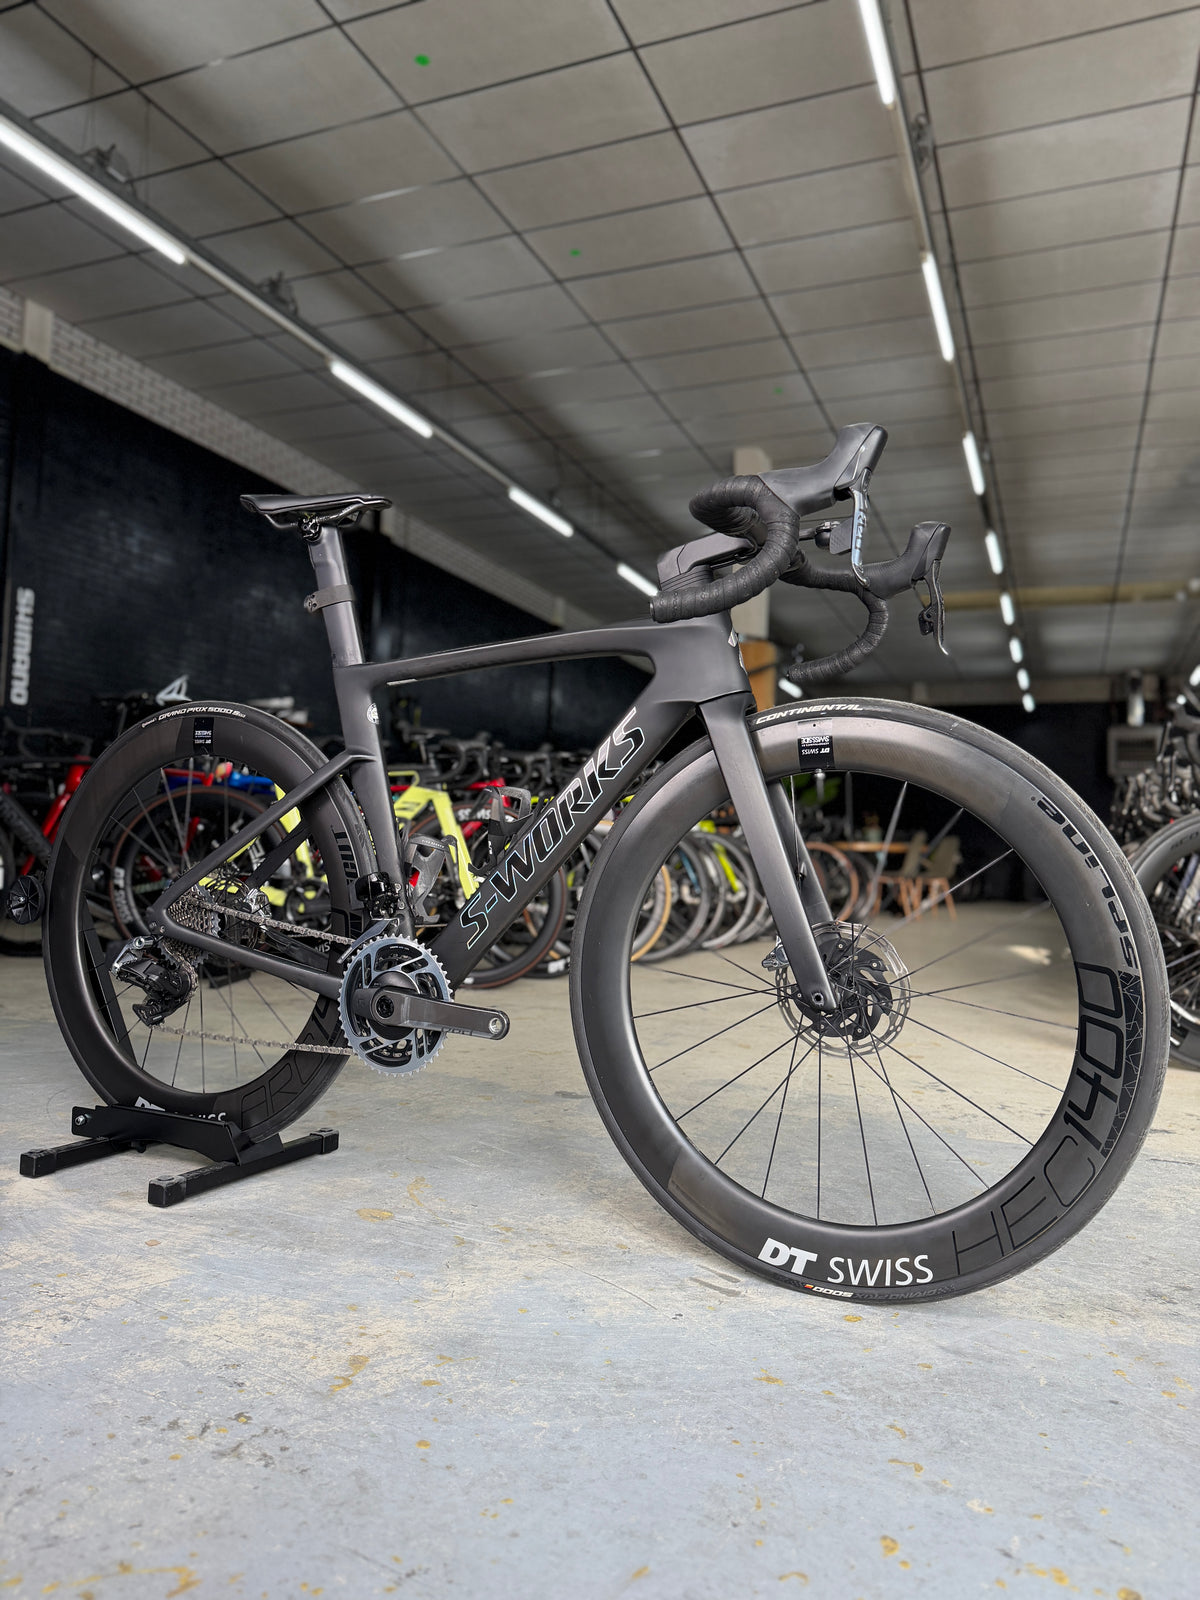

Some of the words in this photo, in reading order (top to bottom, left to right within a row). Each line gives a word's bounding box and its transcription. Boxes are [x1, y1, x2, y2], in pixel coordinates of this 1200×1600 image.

[10, 586, 35, 706] SHIMANO
[158, 709, 187, 720] GRAND
[186, 706, 208, 714] PRIX
[755, 703, 864, 725] CONTINENTAL
[460, 707, 645, 950] S-WORKS
[952, 1135, 1096, 1276] HEC
[1063, 961, 1124, 1152] 1400
[757, 1237, 818, 1276] DT
[826, 1254, 935, 1287] SWISS
[811, 1286, 855, 1298] 5000
